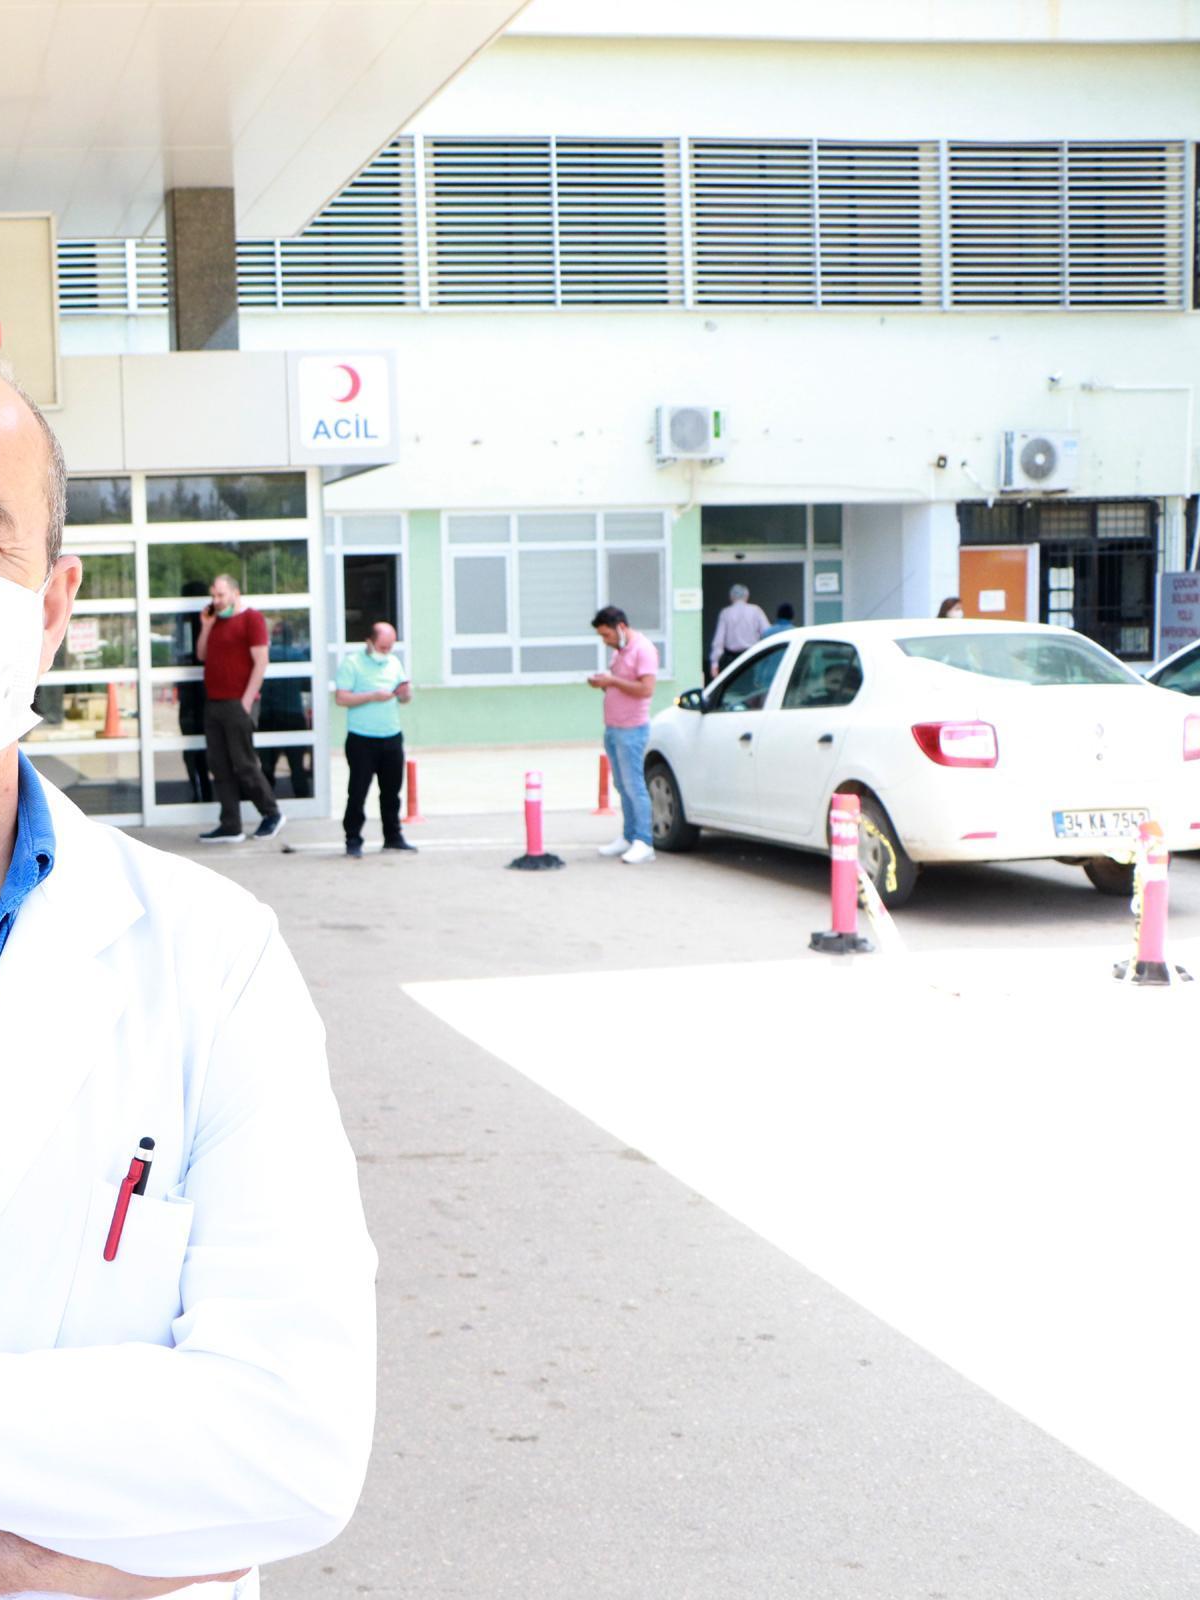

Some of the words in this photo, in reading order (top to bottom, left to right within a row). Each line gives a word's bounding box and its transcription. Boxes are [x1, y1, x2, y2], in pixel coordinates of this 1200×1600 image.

[312, 413, 379, 440] ACİL
[1064, 814, 1083, 831] 34
[1089, 813, 1107, 829] KA
